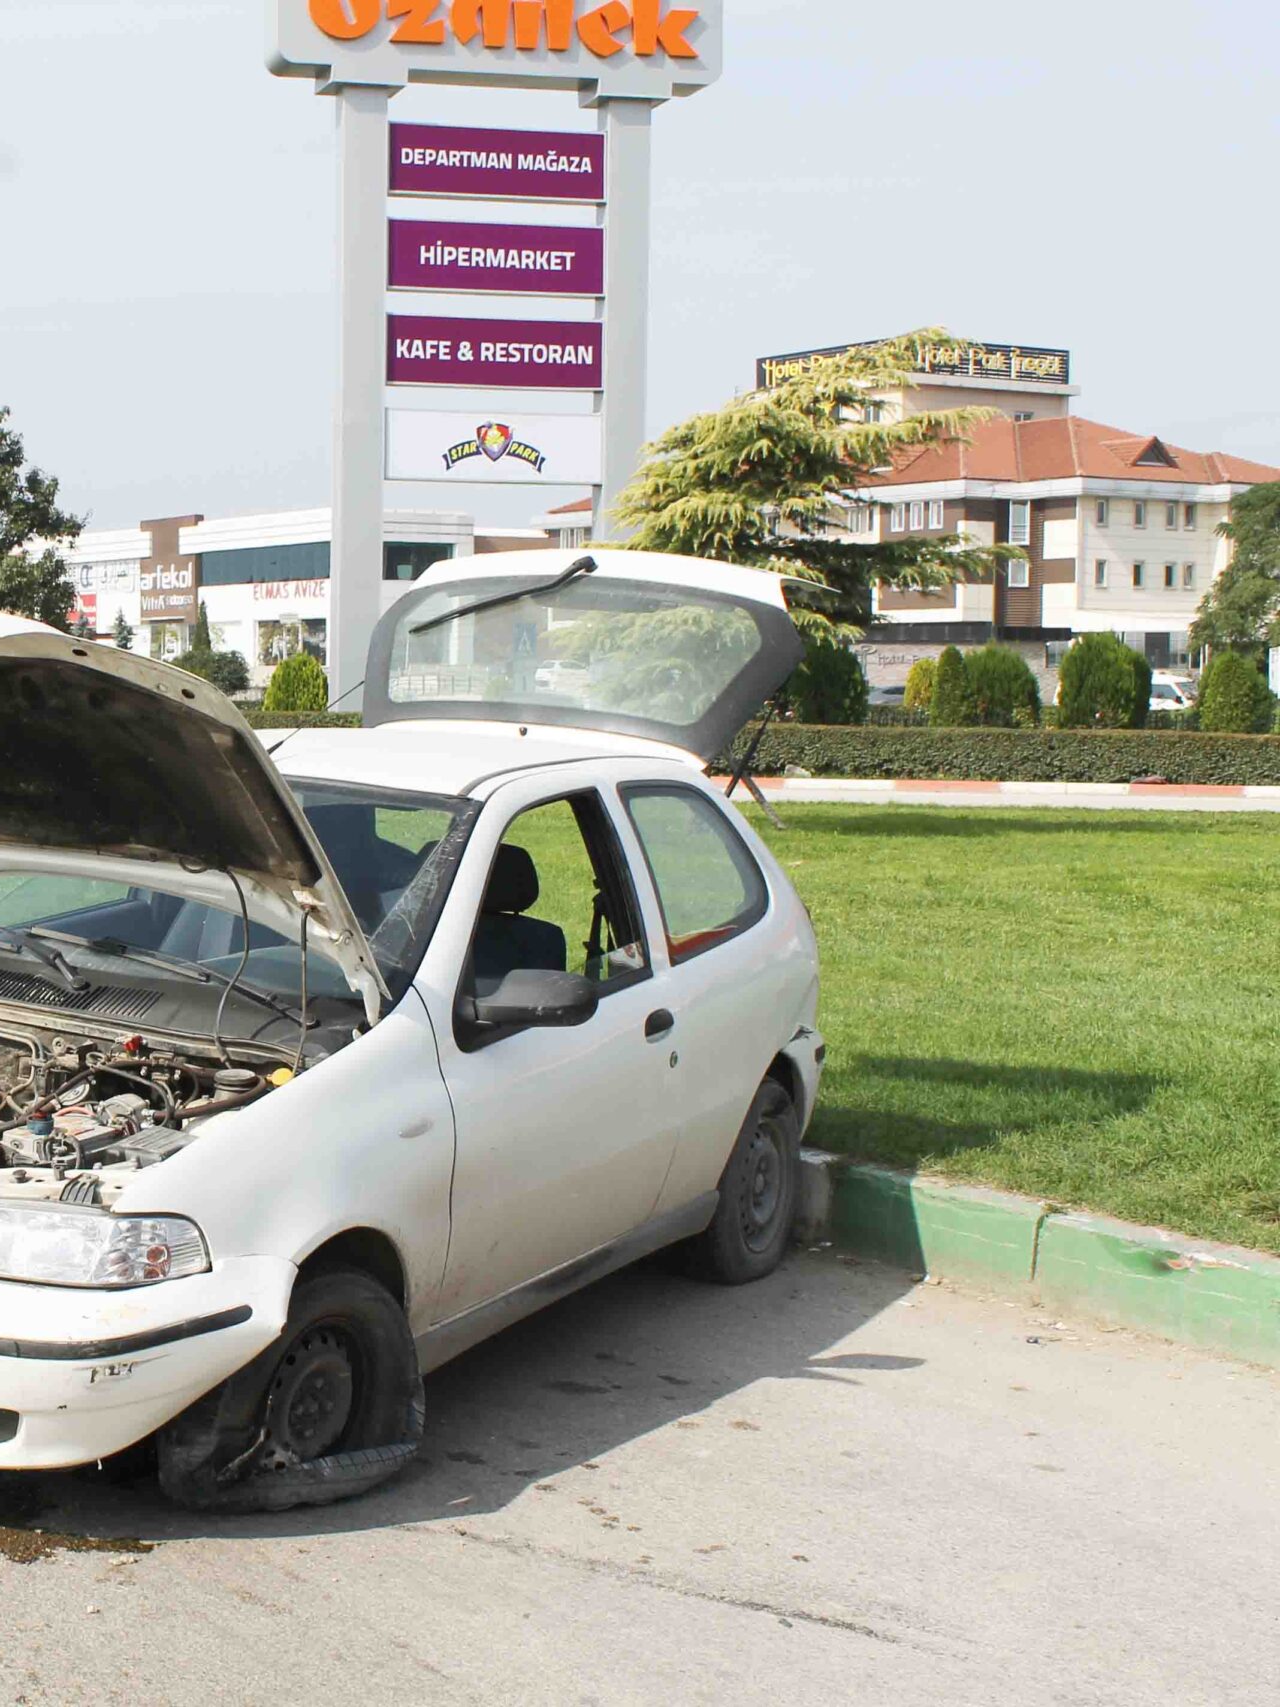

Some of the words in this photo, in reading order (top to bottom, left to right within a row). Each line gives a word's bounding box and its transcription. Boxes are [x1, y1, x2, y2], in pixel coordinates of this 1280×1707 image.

[400, 147, 512, 170] DEPARTMAN
[517, 150, 593, 174] MAĞAZA
[419, 240, 576, 271] HİPERMARKET
[395, 338, 451, 361] KAFE
[456, 340, 474, 362] &
[479, 341, 594, 365] RESTORAN
[450, 442, 477, 460] STAR
[509, 443, 539, 461] PARK
